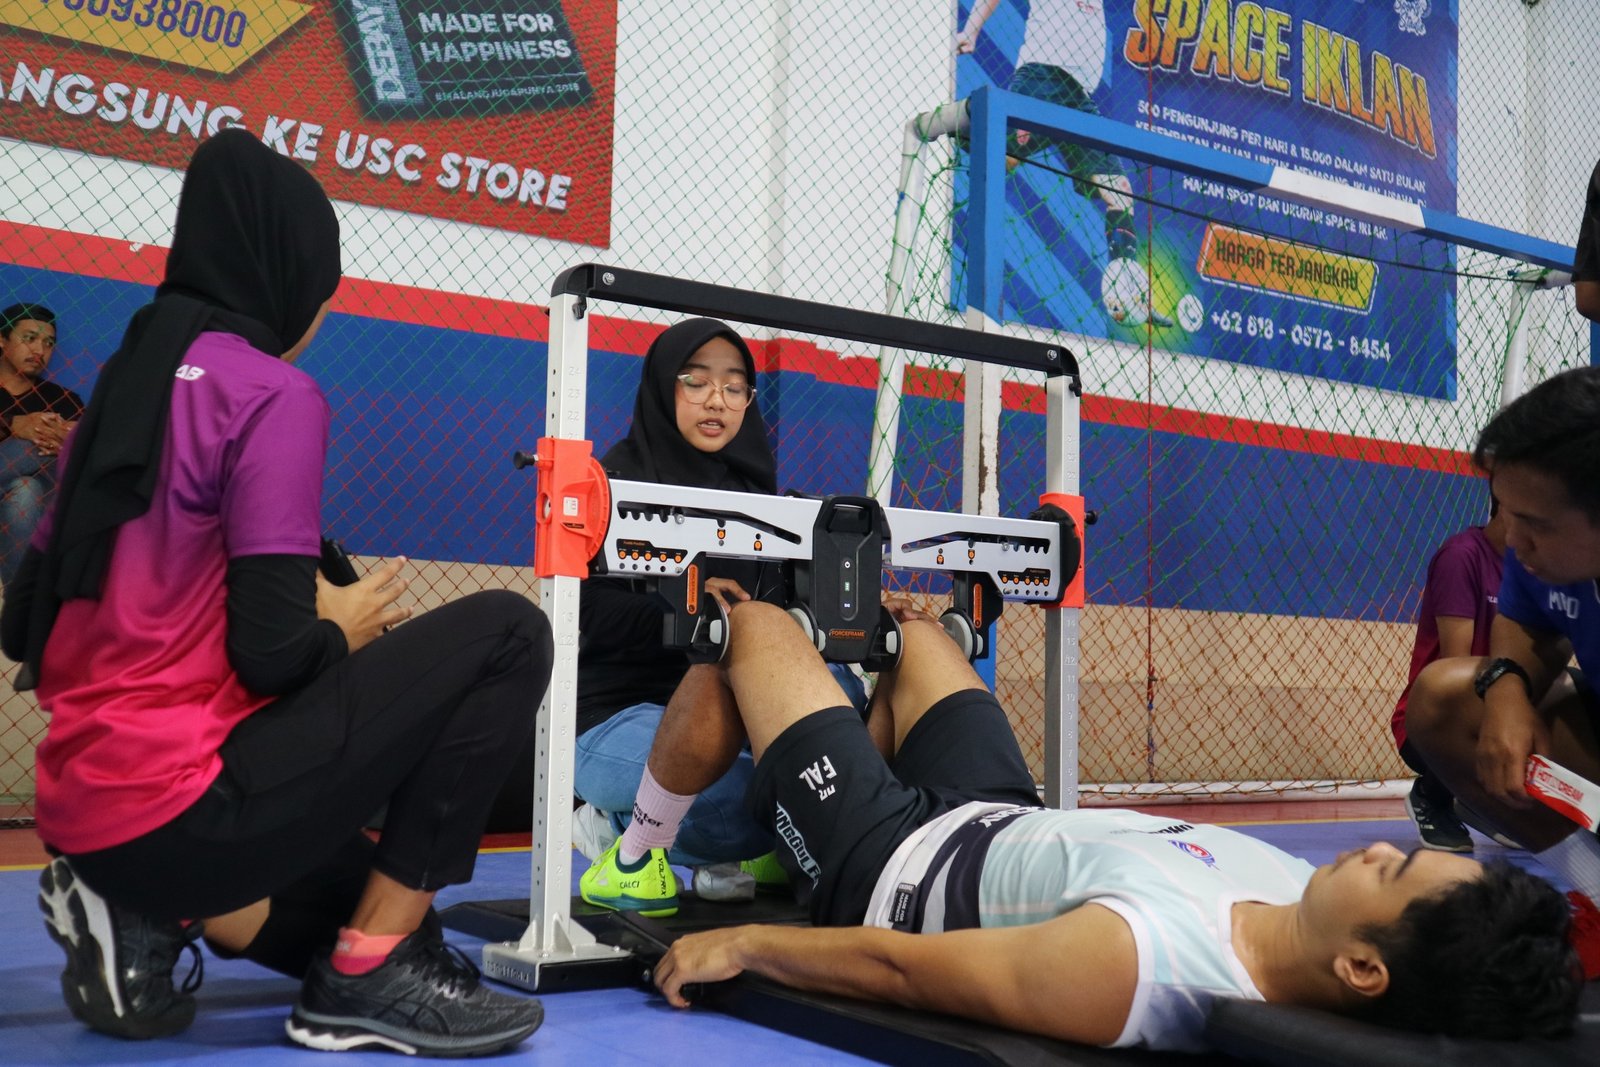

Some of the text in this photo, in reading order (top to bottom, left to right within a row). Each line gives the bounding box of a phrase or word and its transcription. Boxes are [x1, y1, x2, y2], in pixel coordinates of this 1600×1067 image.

[418, 12, 557, 34] MADE FOR
[420, 39, 572, 63] HAPPINESS
[1124, 0, 1437, 159] SPACE IKLAN
[0, 61, 572, 210] NGSUNG KE USC STORE
[1162, 106, 1239, 140] PENGUNJUNG
[1241, 129, 1262, 148] PER
[1264, 135, 1288, 155] HARI
[1290, 143, 1298, 158] &
[1300, 146, 1333, 167] 15.000
[1334, 156, 1368, 177] DALAM
[1369, 166, 1394, 185] SATU
[1396, 174, 1426, 194] BULAN
[1226, 188, 1256, 207] SPOT
[1258, 194, 1280, 213] DAN
[1282, 201, 1324, 225] UKURAN
[1325, 213, 1357, 232] SPACE
[1215, 238, 1359, 291] HARGA TERJANGKAU
[1211, 309, 1243, 334] +62
[1291, 324, 1334, 351] 0572
[1349, 335, 1392, 362] 8454
[831, 629, 865, 638] FORCEFRAME
[798, 755, 838, 791] FAL
